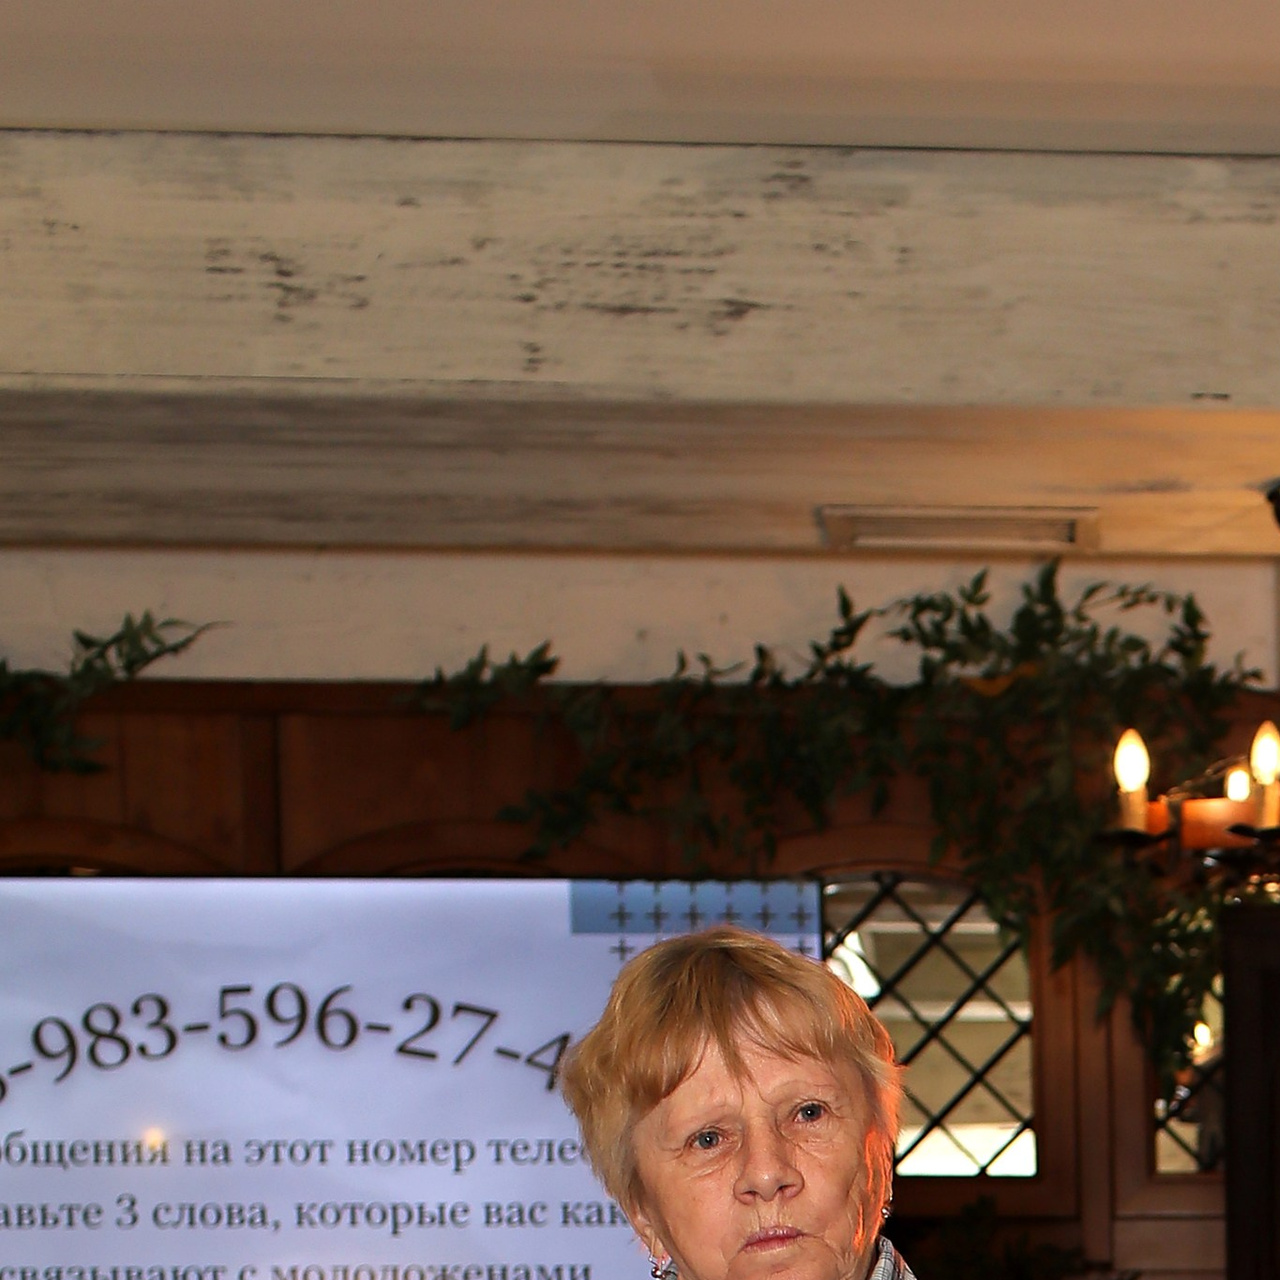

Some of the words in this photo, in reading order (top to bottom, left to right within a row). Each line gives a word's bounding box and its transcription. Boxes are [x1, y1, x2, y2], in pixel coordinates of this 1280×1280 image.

[0, 1128, 171, 1170] бщения
[184, 1138, 232, 1166] на
[245, 1138, 334, 1166] этот
[346, 1138, 476, 1174] номер
[115, 1192, 140, 1230] 3
[152, 1202, 281, 1235] слова,
[295, 1200, 470, 1237] которые
[484, 1201, 548, 1228] вас
